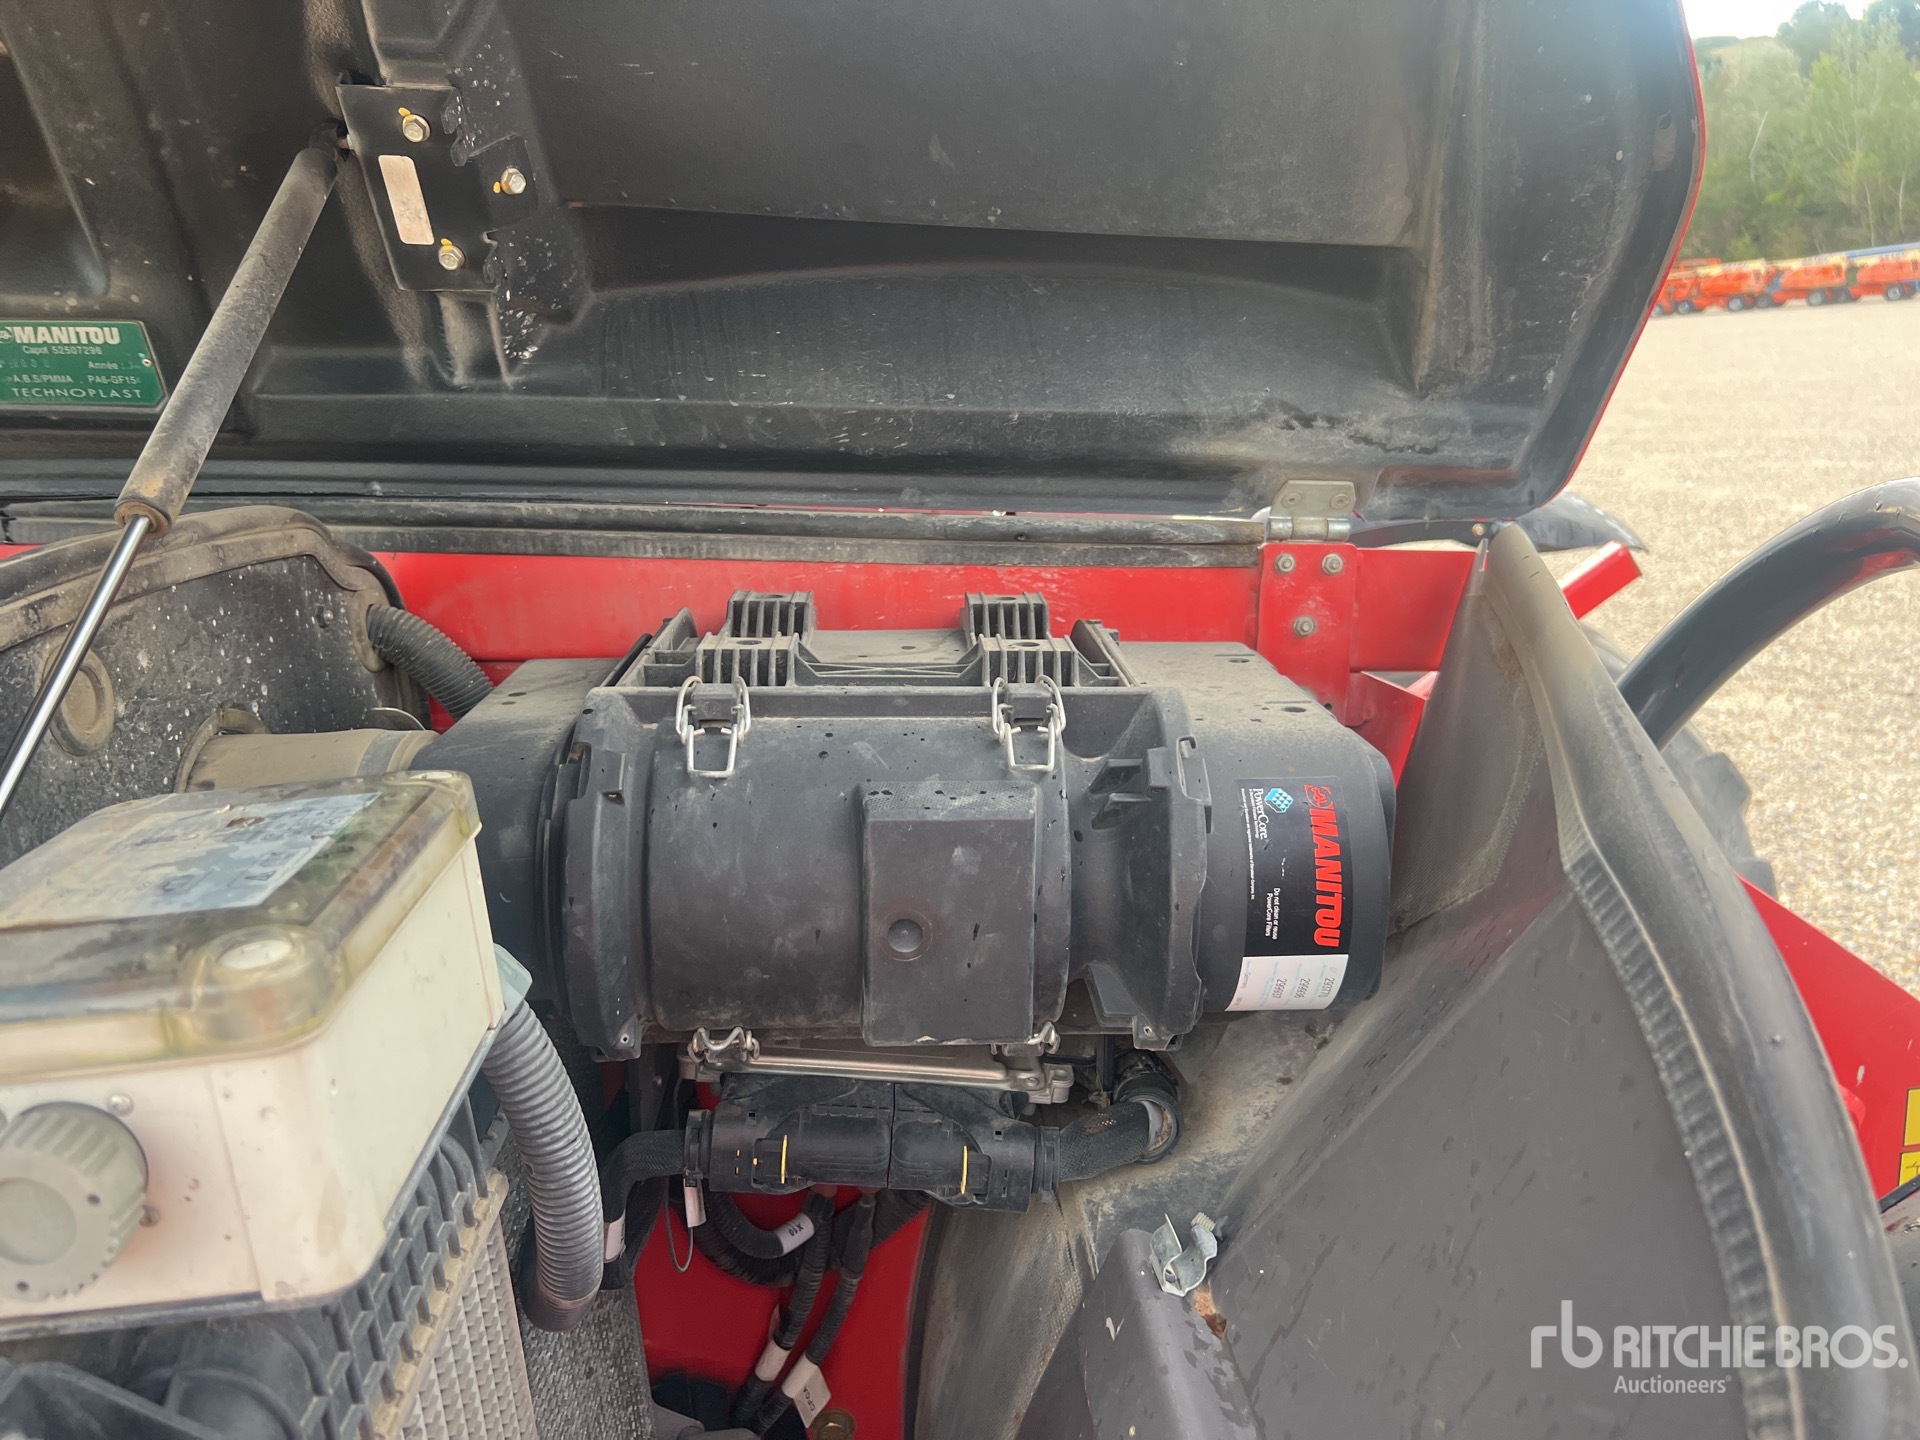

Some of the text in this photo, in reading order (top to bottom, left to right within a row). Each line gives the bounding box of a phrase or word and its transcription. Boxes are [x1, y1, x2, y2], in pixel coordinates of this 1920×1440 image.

[12, 326, 121, 345] MANITOU
[22, 346, 103, 356] Capot 52507296
[88, 361, 119, 370] Année
[11, 387, 143, 399] TECHNOPLAST
[1252, 788, 1269, 839] PowerCore
[1309, 808, 1343, 947] MANITOU
[1274, 887, 1281, 896] Do
[1266, 892, 1274, 921] PowerCore
[788, 1222, 804, 1237] X10
